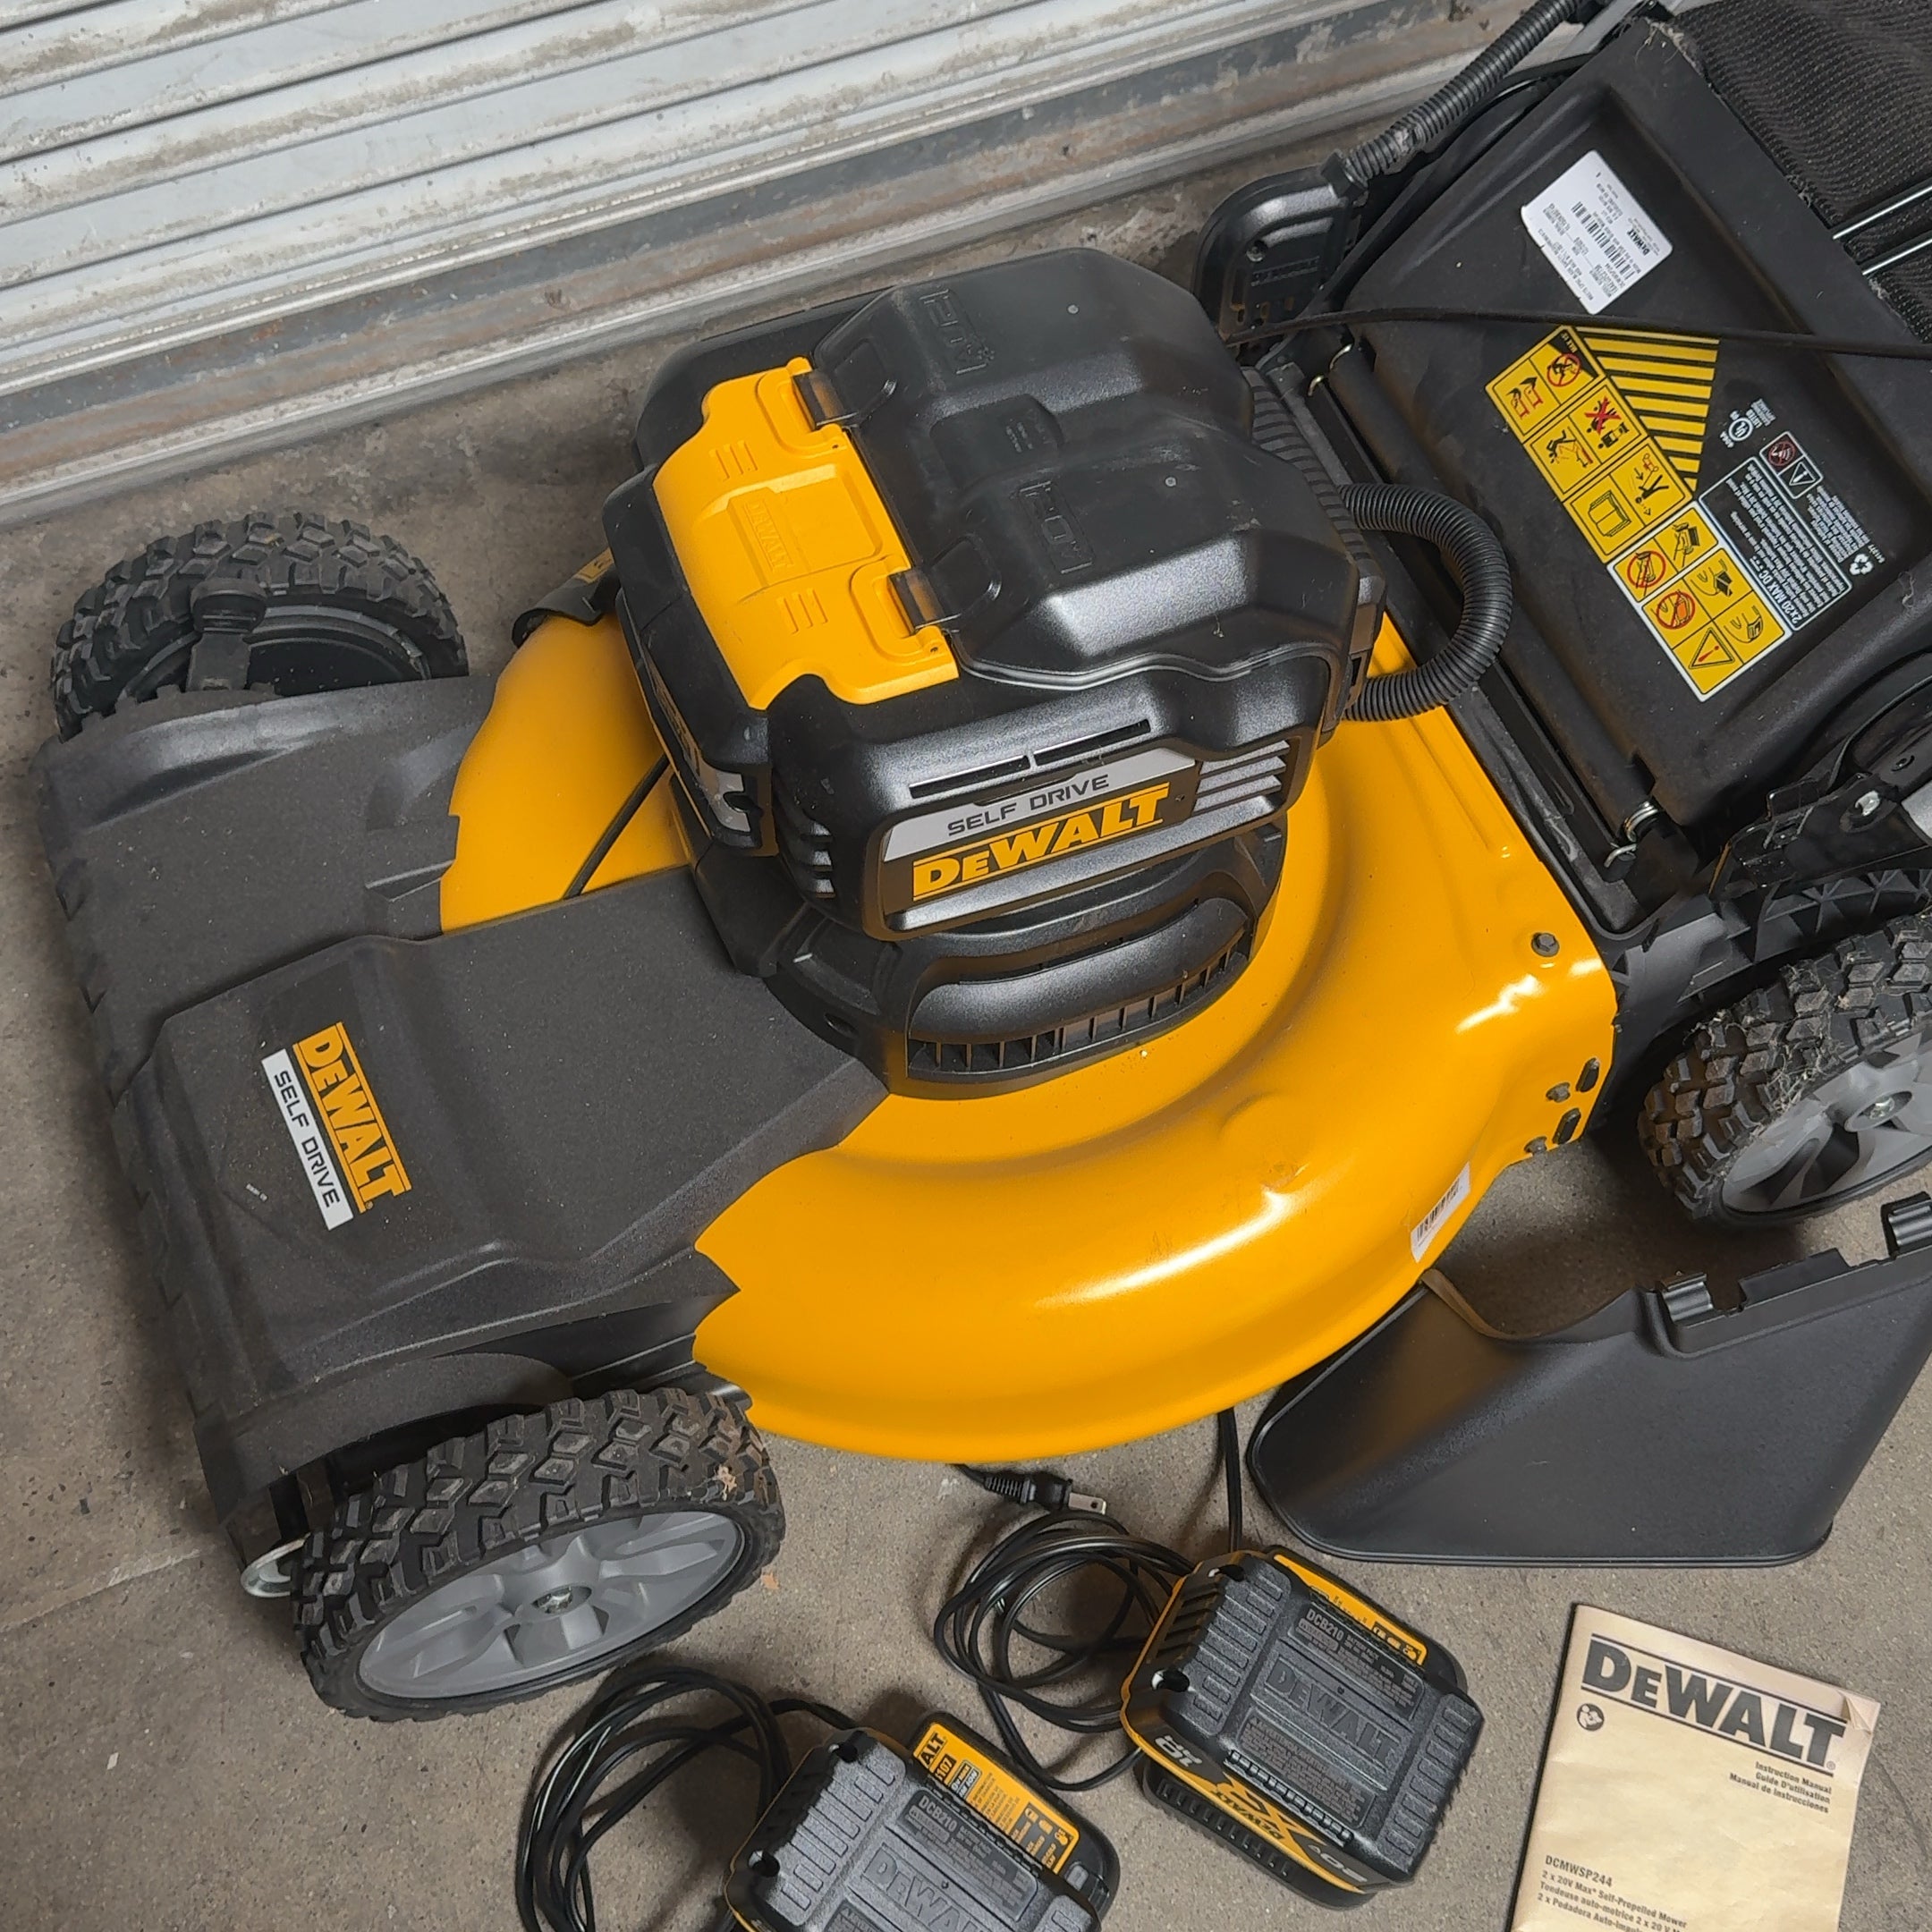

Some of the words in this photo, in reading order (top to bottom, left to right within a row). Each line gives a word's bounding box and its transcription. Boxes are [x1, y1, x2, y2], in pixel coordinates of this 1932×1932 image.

[1759, 570, 1771, 583] DC
[1768, 581, 1785, 602] MAX
[948, 804, 1019, 836] SELF
[1030, 775, 1110, 810] DRIVE
[274, 1070, 309, 1130] SELF
[301, 1136, 340, 1208] DRIVE
[1305, 1609, 1345, 1640] DCB210
[919, 1733, 945, 1763] ALT
[934, 1758, 953, 1779] 107
[1756, 1761, 1800, 1783] Instruction
[1801, 1777, 1832, 1794] Manual
[1729, 1773, 1759, 1790] Manual
[1761, 1785, 1771, 1793] de
[1773, 1788, 1829, 1814] Instrucciones
[1756, 1772, 1779, 1785] Guide
[1781, 1781, 1831, 1804] D'utilisation
[919, 1797, 957, 1830] DCB210
[1545, 1854, 1613, 1887] DCMWSP244
[863, 1847, 983, 1932] DEWA
[1538, 1893, 1544, 1901] 2
[1553, 1898, 1592, 1919] Podadora
[1540, 1881, 1580, 1902] Tondeuse
[1581, 1895, 1634, 1922] auto-motrice
[1541, 1870, 1548, 1878] 2
[1557, 1876, 1574, 1888] 20V
[1598, 1890, 1657, 1918] Self-Propelled
[1659, 1910, 1688, 1929] Mower
